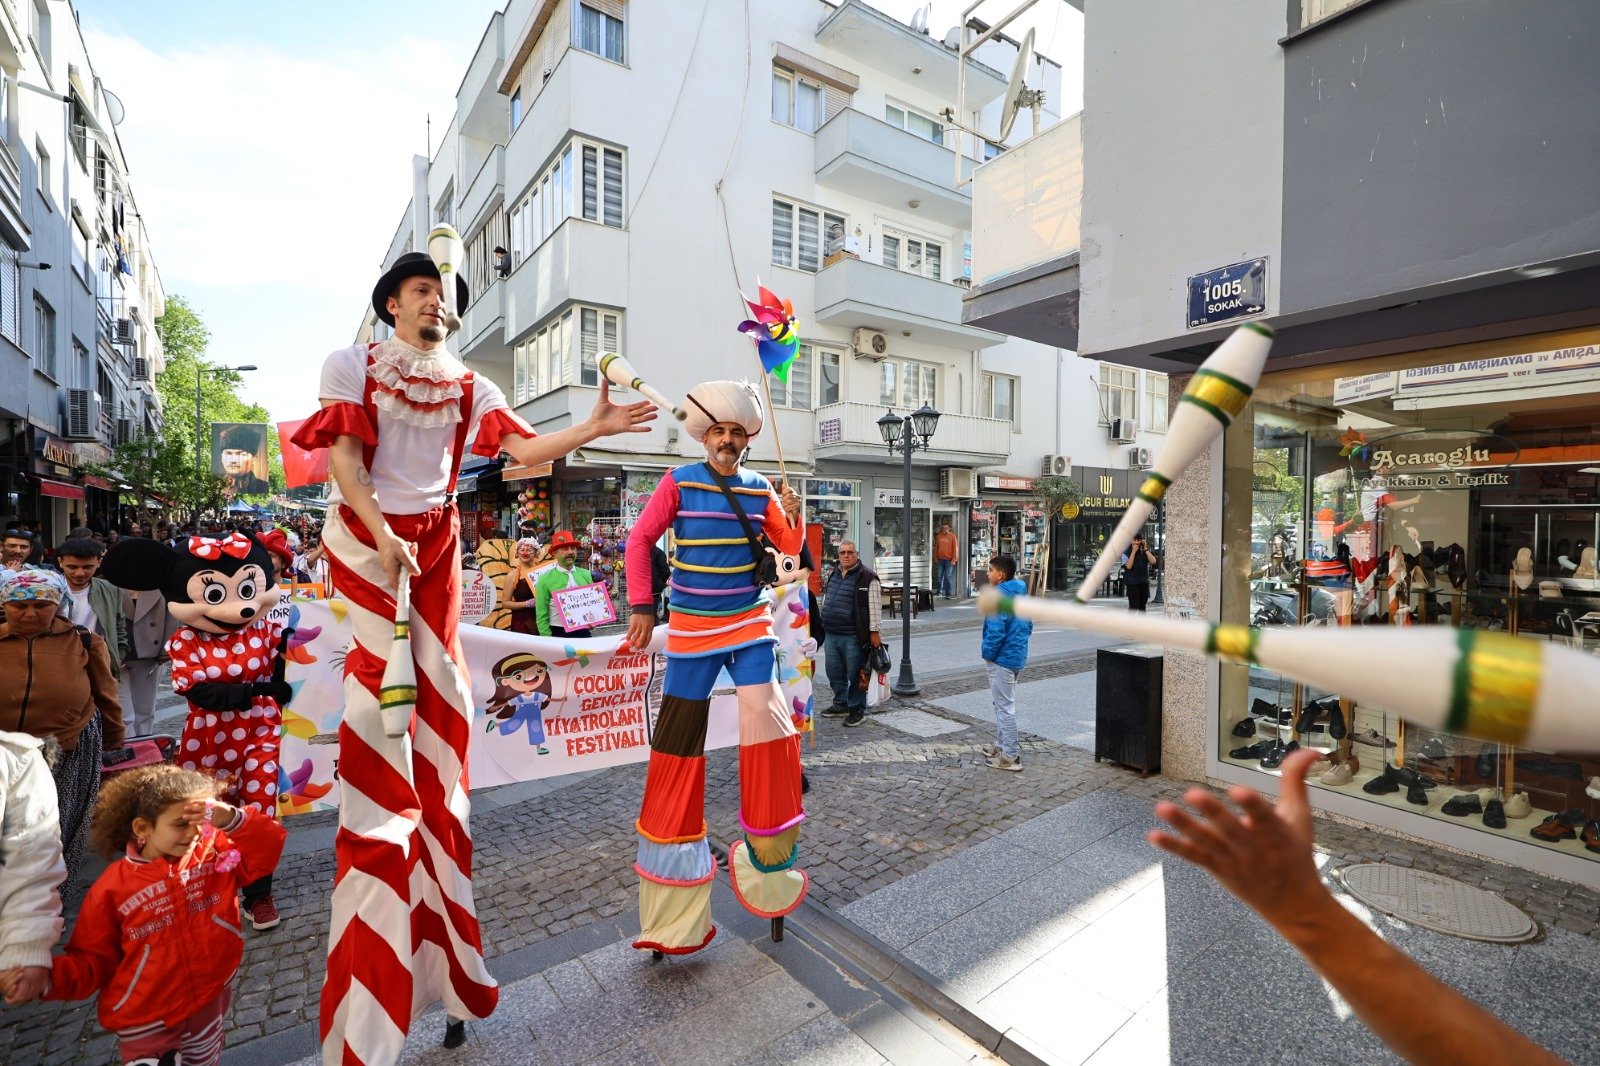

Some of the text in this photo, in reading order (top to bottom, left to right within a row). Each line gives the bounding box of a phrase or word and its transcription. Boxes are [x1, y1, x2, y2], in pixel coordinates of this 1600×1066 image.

[1203, 279, 1247, 302] 1005.
[1208, 298, 1243, 314] SOKAK
[1370, 446, 1490, 471] Acaroglu
[1361, 473, 1509, 488] Ayakkabı & Terlik
[1104, 497, 1130, 508] EMLAK
[474, 572, 484, 586] 2
[574, 672, 649, 698] ÇOCUK VE
[581, 689, 643, 712] GENÇLİK
[544, 706, 644, 737] TİYATROLARI
[143, 895, 170, 912] RUGBY
